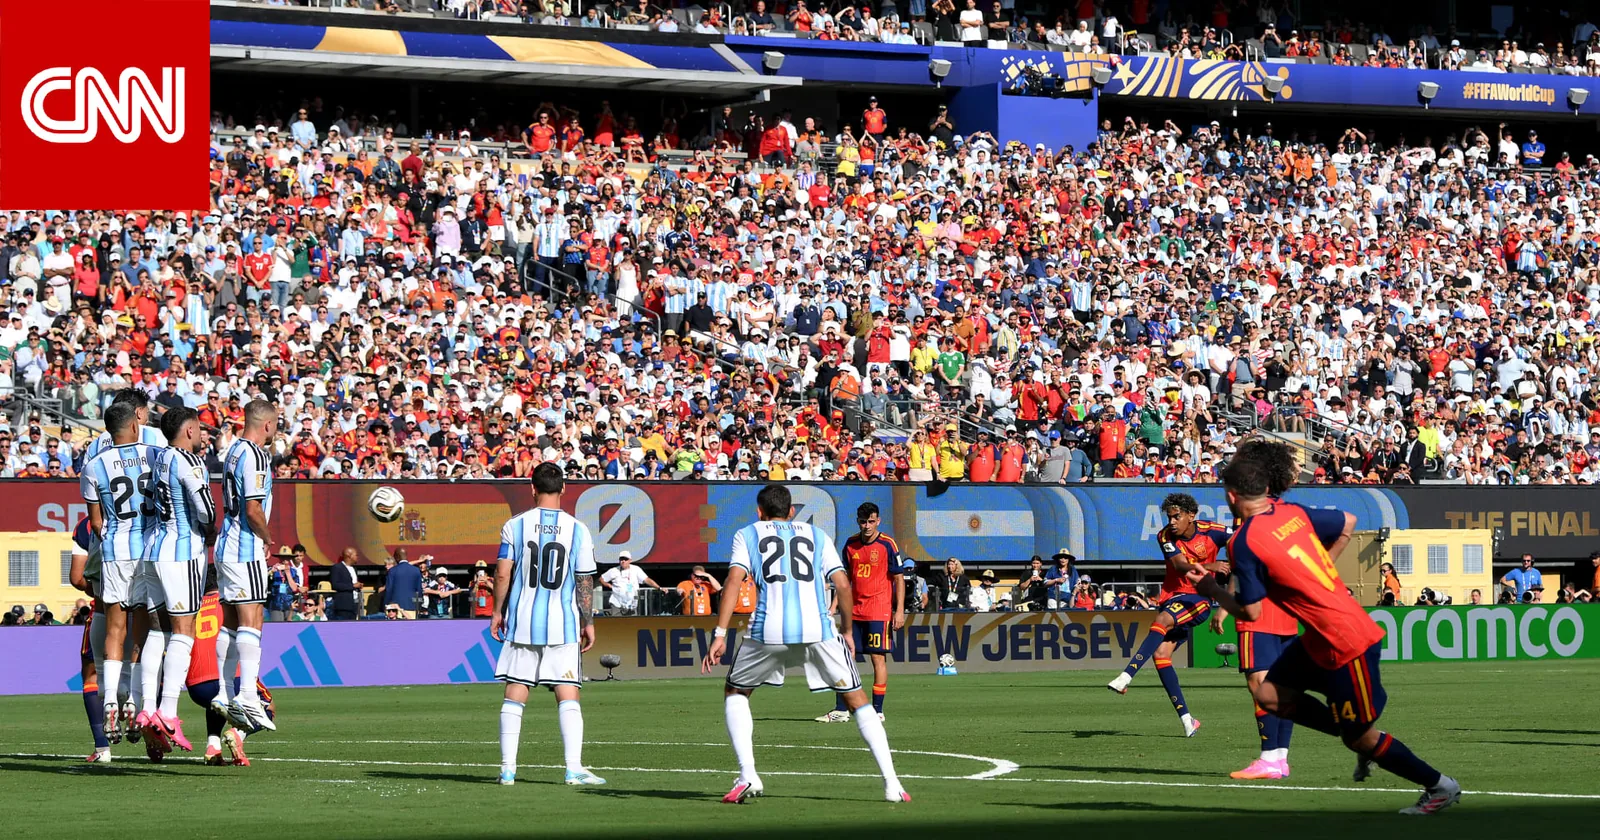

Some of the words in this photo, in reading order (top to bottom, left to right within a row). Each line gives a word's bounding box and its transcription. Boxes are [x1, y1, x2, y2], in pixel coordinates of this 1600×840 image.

[1462, 81, 1556, 106] #FIFAWorldCup
[113, 456, 148, 470] MEDINA
[534, 524, 562, 536] MESSI
[765, 524, 804, 532] MOLINA
[1510, 511, 1600, 537] FINAL
[527, 540, 566, 591] 10
[758, 536, 815, 584] 26
[856, 563, 871, 578] 20
[1287, 532, 1340, 592] 14
[195, 603, 219, 640] 6
[1367, 606, 1585, 661] aramco
[867, 632, 881, 648] 20
[982, 621, 1139, 662] JERSEY
[1331, 700, 1357, 723] 14
